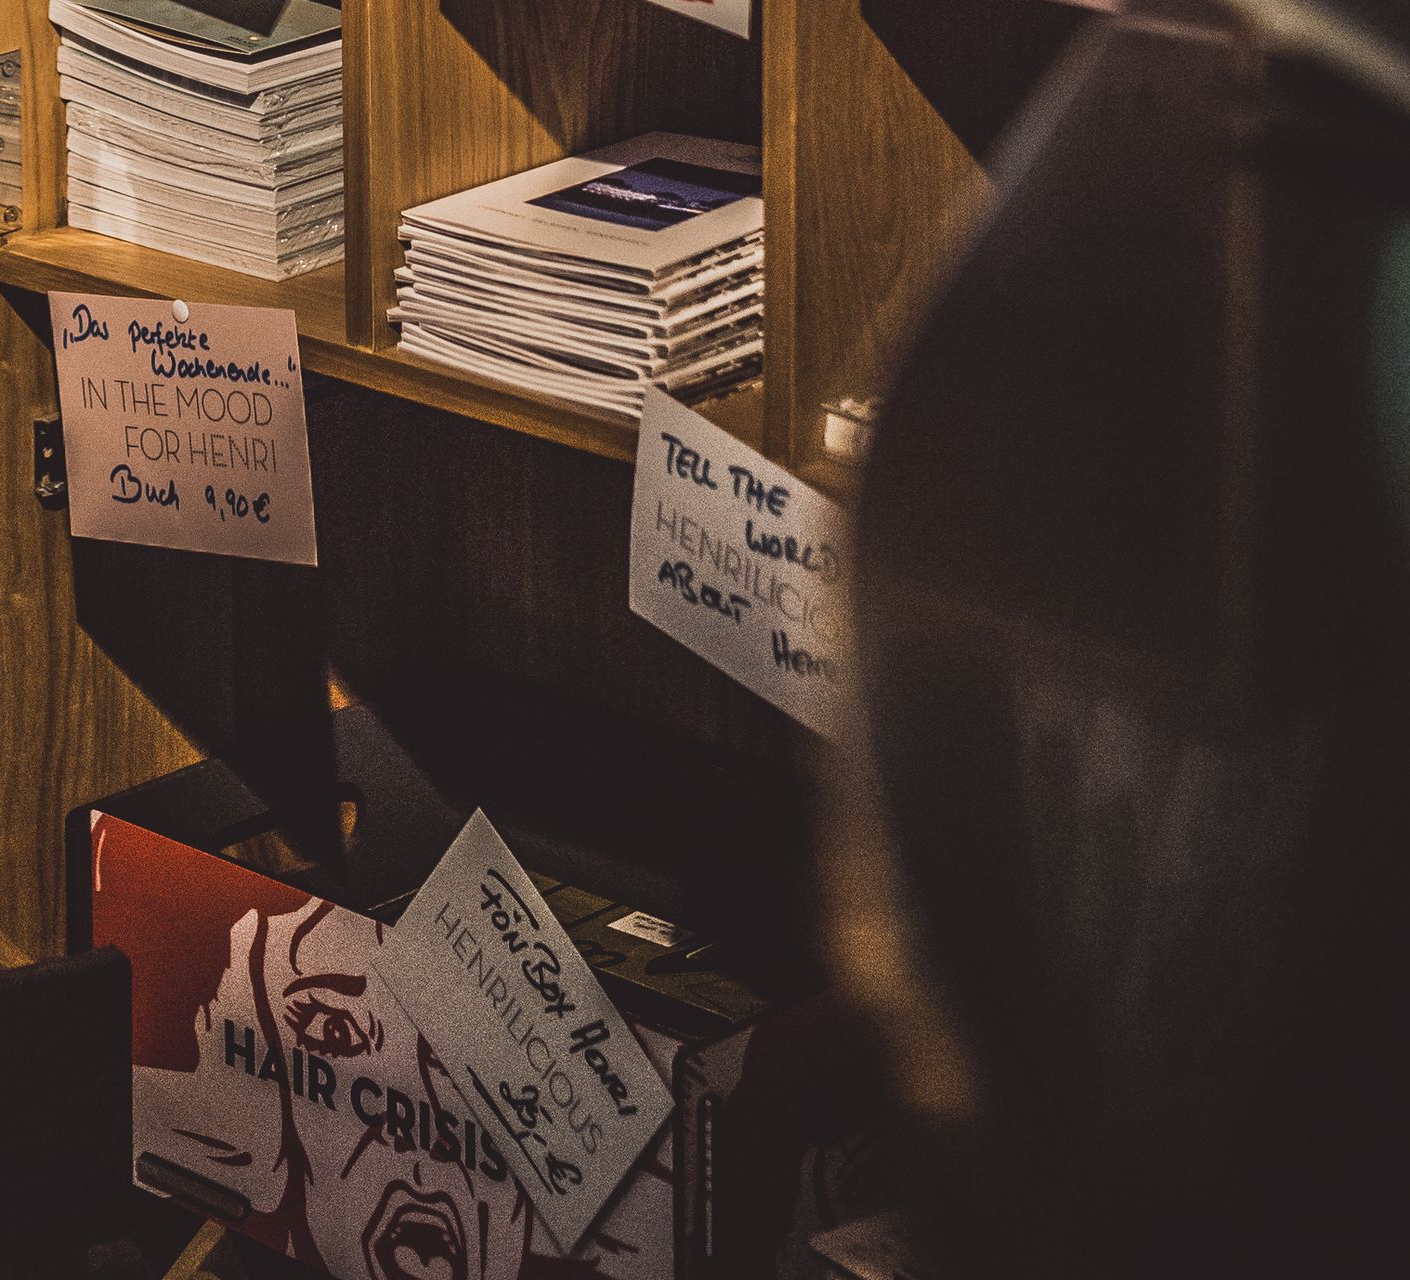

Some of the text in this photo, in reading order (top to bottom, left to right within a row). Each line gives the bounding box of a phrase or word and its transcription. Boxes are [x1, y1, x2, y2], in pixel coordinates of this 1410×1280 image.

[80, 376, 273, 426] IN THE MOOD
[124, 425, 278, 473] FOR HENRI
[661, 432, 790, 518] TELL THE
[110, 464, 180, 511] Buch
[658, 560, 750, 625] ABOUT
[434, 901, 604, 1156] HENRILICIOUS
[222, 1017, 510, 1185] HAIR CRISIS
